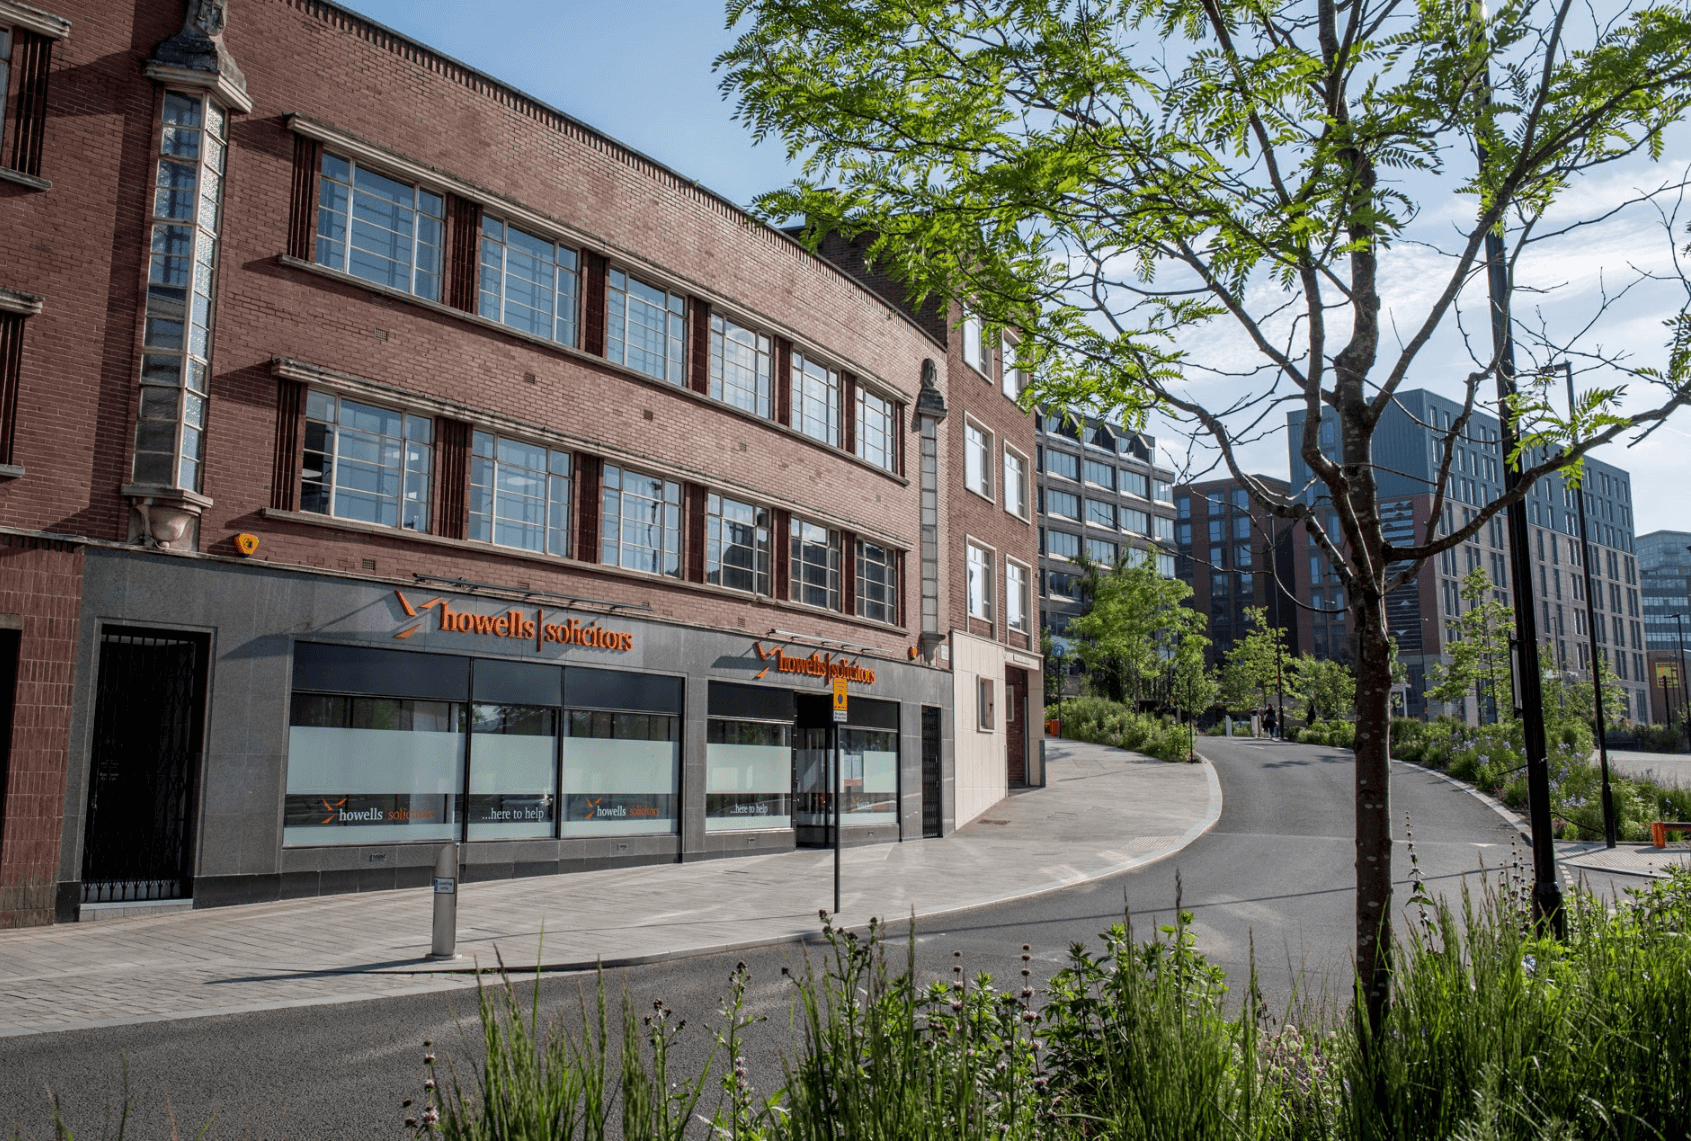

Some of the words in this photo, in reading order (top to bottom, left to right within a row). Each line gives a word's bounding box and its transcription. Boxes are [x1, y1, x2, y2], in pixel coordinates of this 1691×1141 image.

[440, 601, 536, 640] howells
[544, 618, 633, 651] solicitors
[777, 648, 827, 677] howells
[829, 658, 876, 684] solicitors
[339, 807, 384, 821] howells
[513, 809, 523, 820] to
[525, 807, 545, 822] help
[596, 805, 627, 817] howells
[749, 805, 755, 814] to
[756, 803, 769, 816] help
